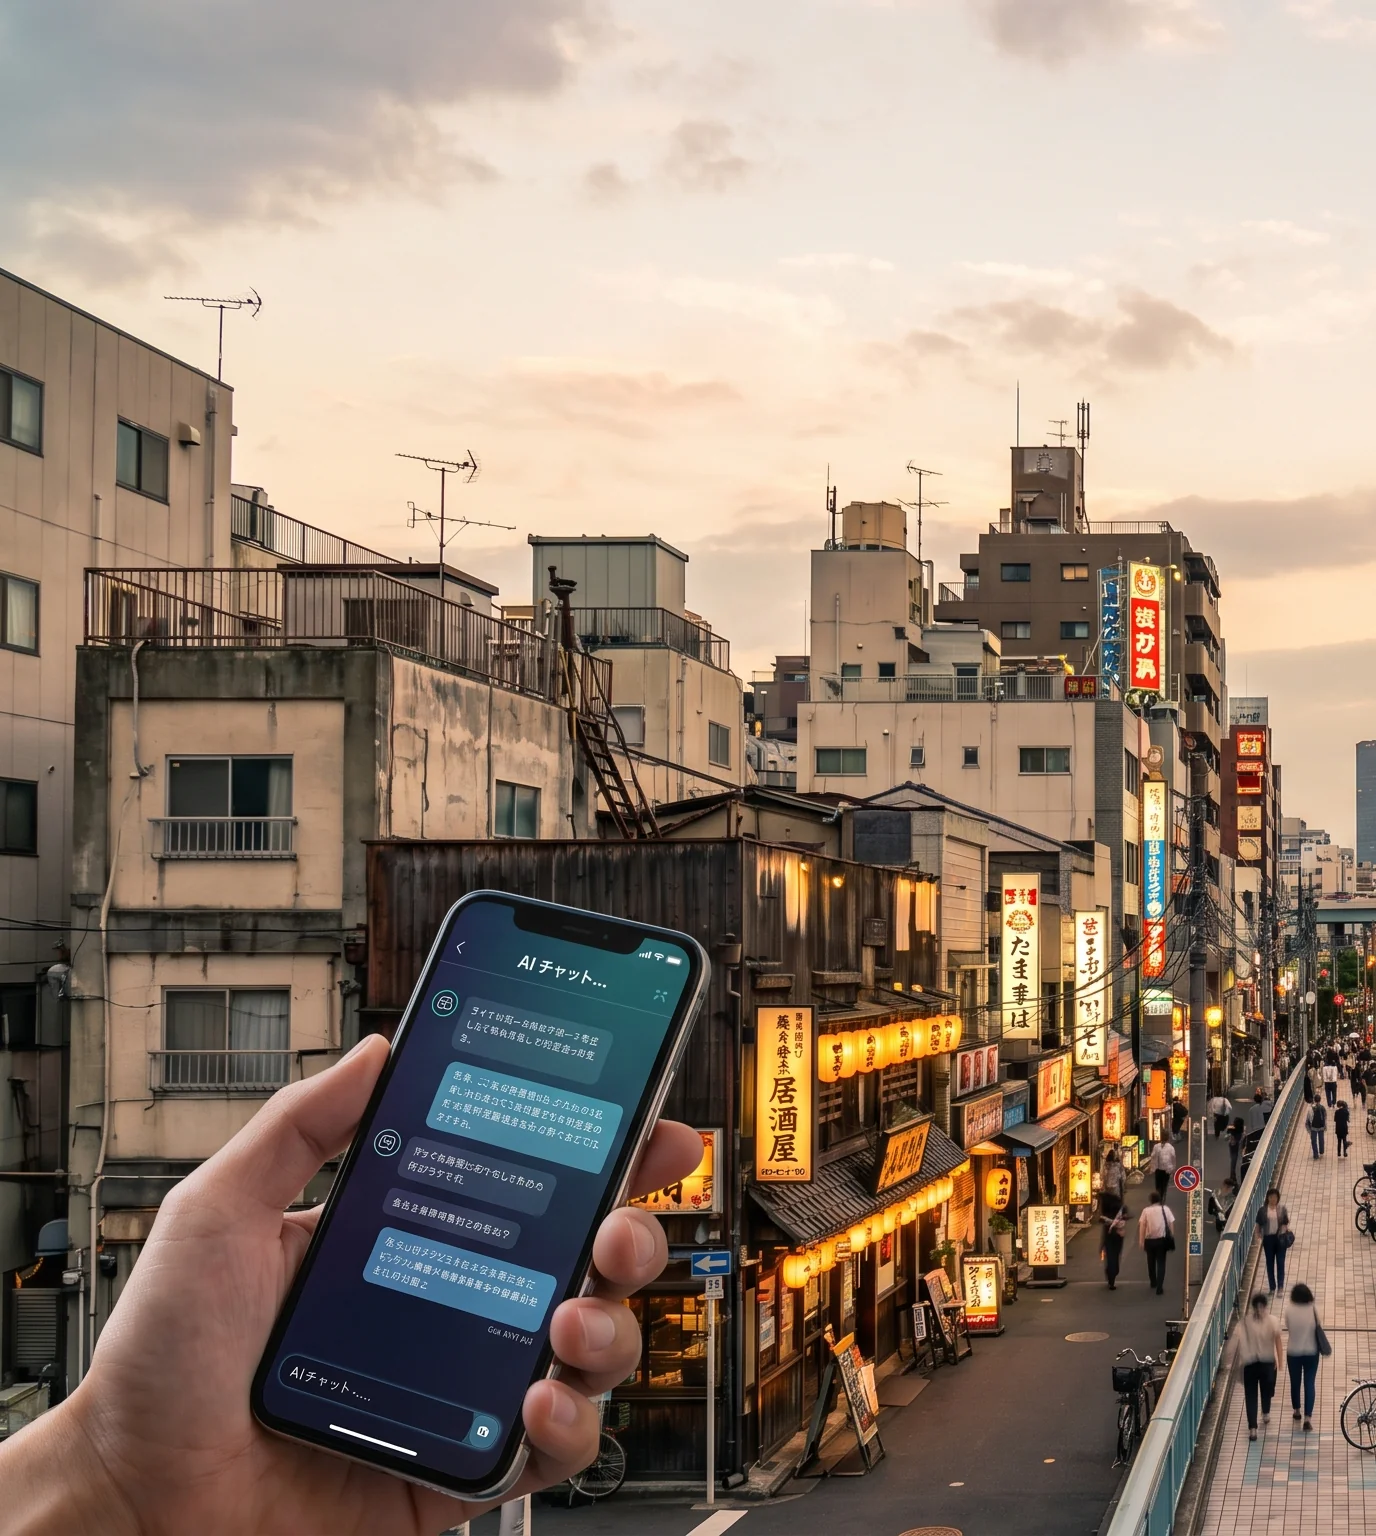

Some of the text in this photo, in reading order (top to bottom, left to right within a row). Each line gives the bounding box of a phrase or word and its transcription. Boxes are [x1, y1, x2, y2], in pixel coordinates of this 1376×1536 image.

[517, 955, 536, 971] AI
[768, 1077, 799, 1163] 居酒屋
